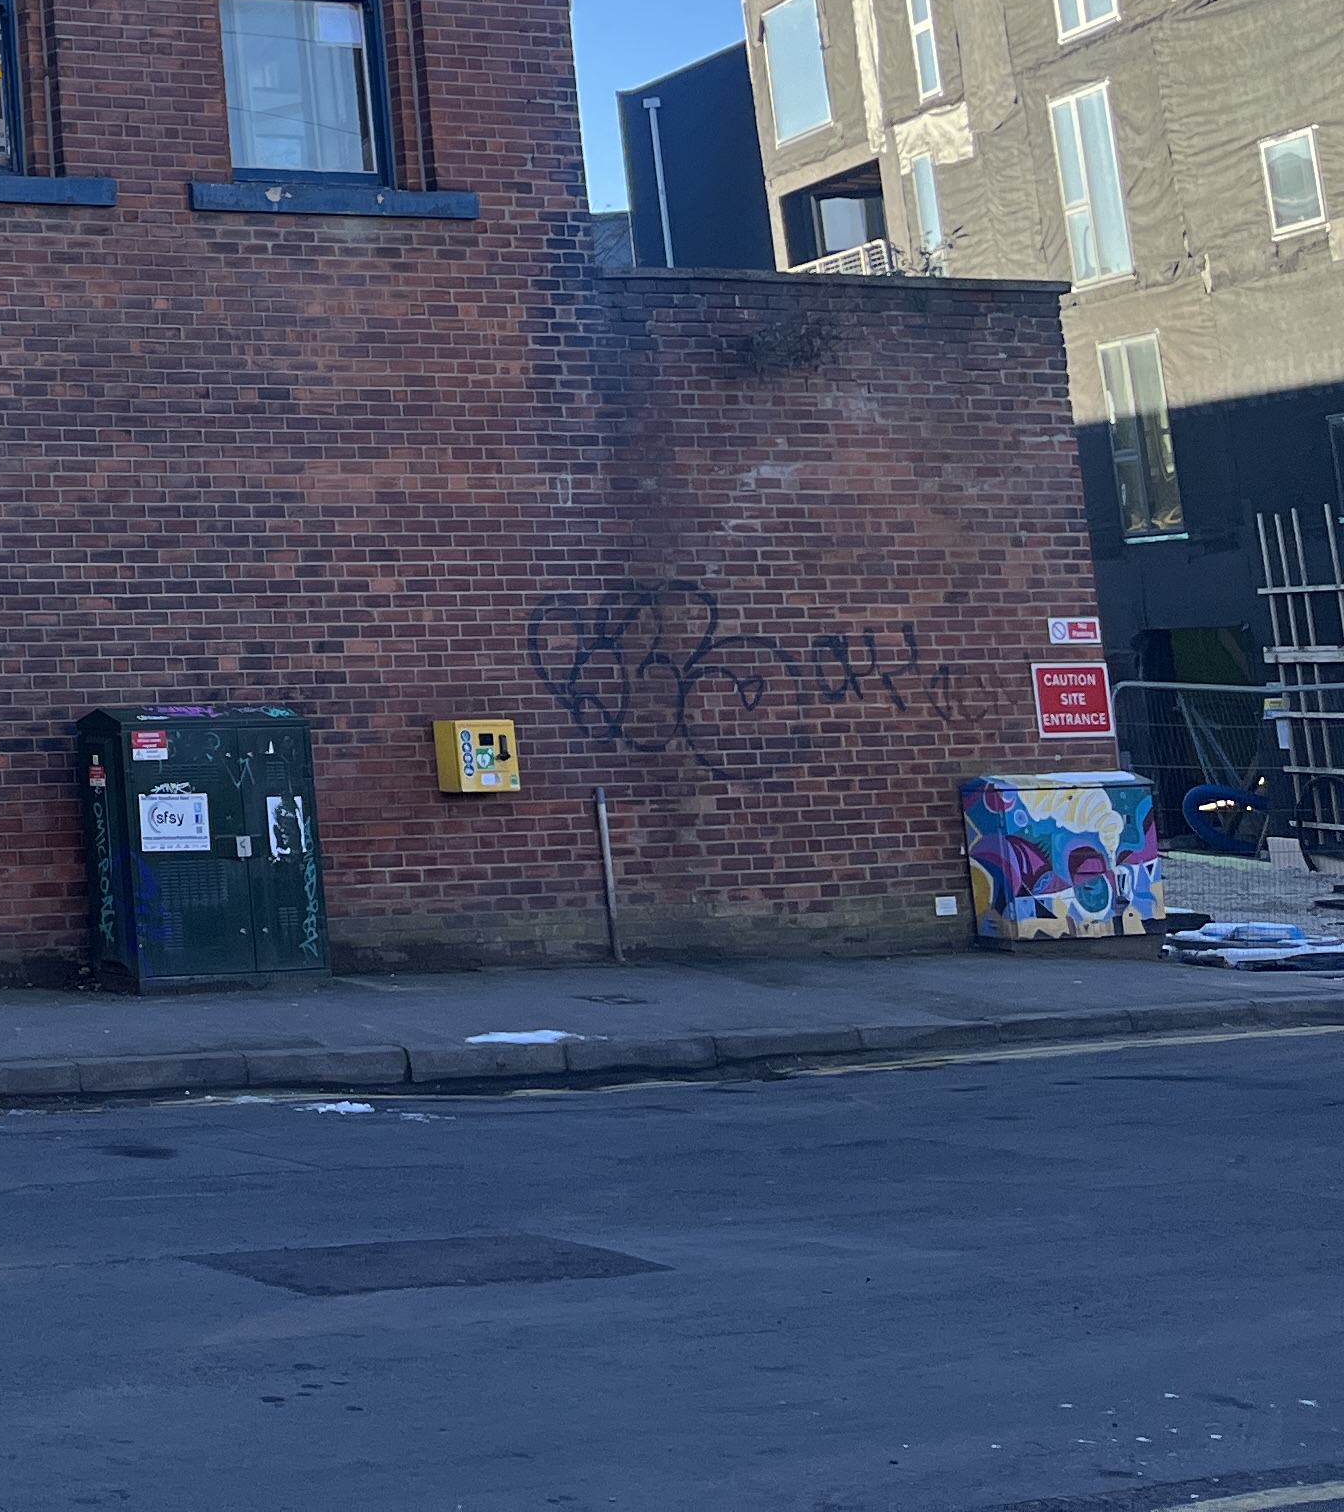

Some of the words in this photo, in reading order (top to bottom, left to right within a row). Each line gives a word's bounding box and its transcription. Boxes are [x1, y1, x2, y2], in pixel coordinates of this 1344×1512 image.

[1043, 673, 1097, 686] CAUTION
[1060, 692, 1087, 706] SITE
[1042, 712, 1107, 726] ENTRANCE
[156, 811, 184, 827] sfsy
